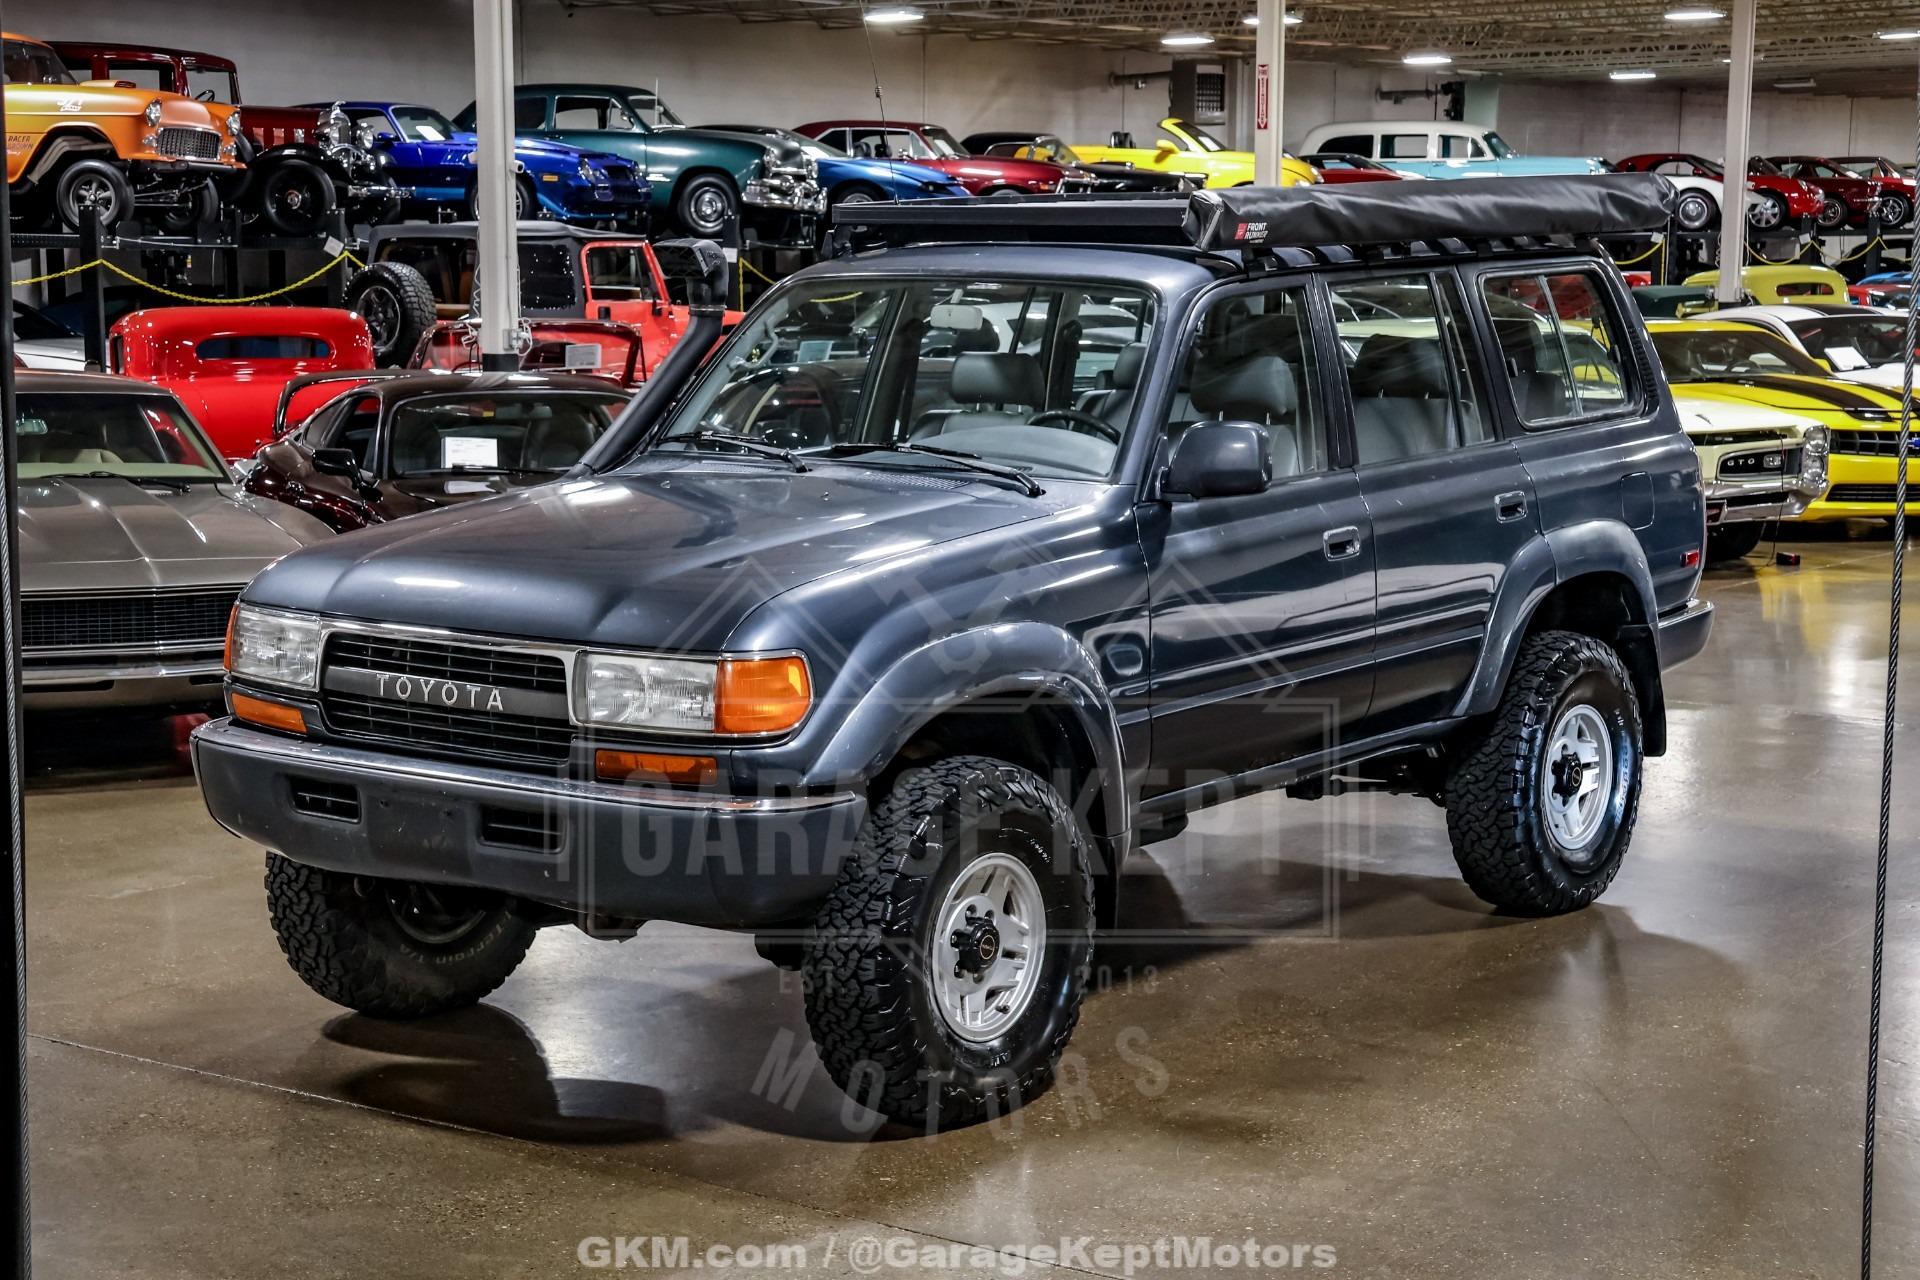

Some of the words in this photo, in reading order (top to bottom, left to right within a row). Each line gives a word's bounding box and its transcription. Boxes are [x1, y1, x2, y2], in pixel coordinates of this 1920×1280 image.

[8, 135, 31, 143] RACER
[1247, 222, 1267, 231] FRONT
[1727, 458, 1755, 466] GTO
[376, 673, 503, 711] TOYOTA
